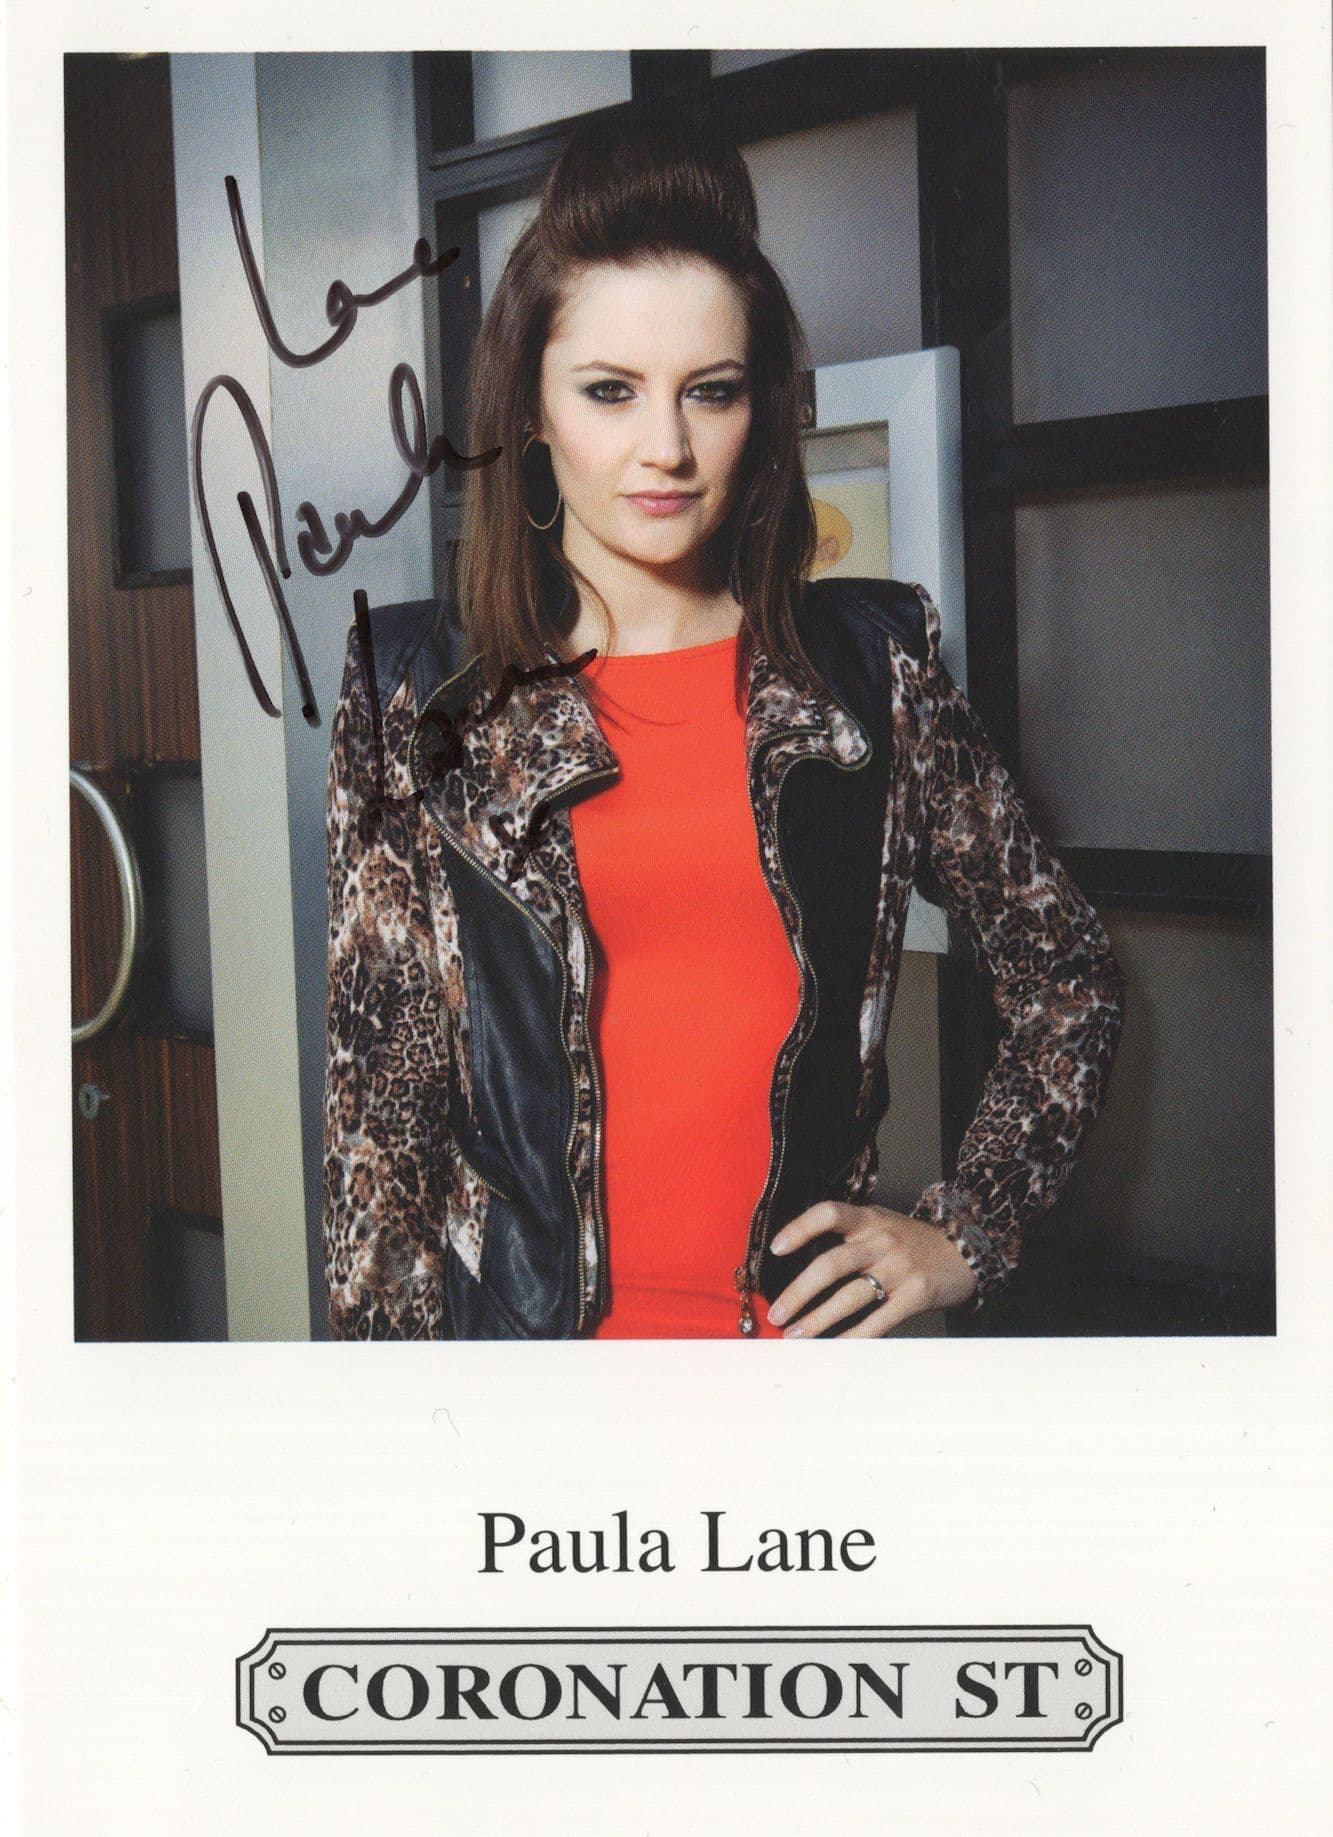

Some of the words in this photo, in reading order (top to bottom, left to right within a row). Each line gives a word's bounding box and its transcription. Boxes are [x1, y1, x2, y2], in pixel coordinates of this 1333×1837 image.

[477, 1510, 676, 1573] Paula
[700, 1511, 877, 1572] Lane
[302, 1662, 910, 1722] CORONATION
[955, 1661, 1059, 1719] ST
